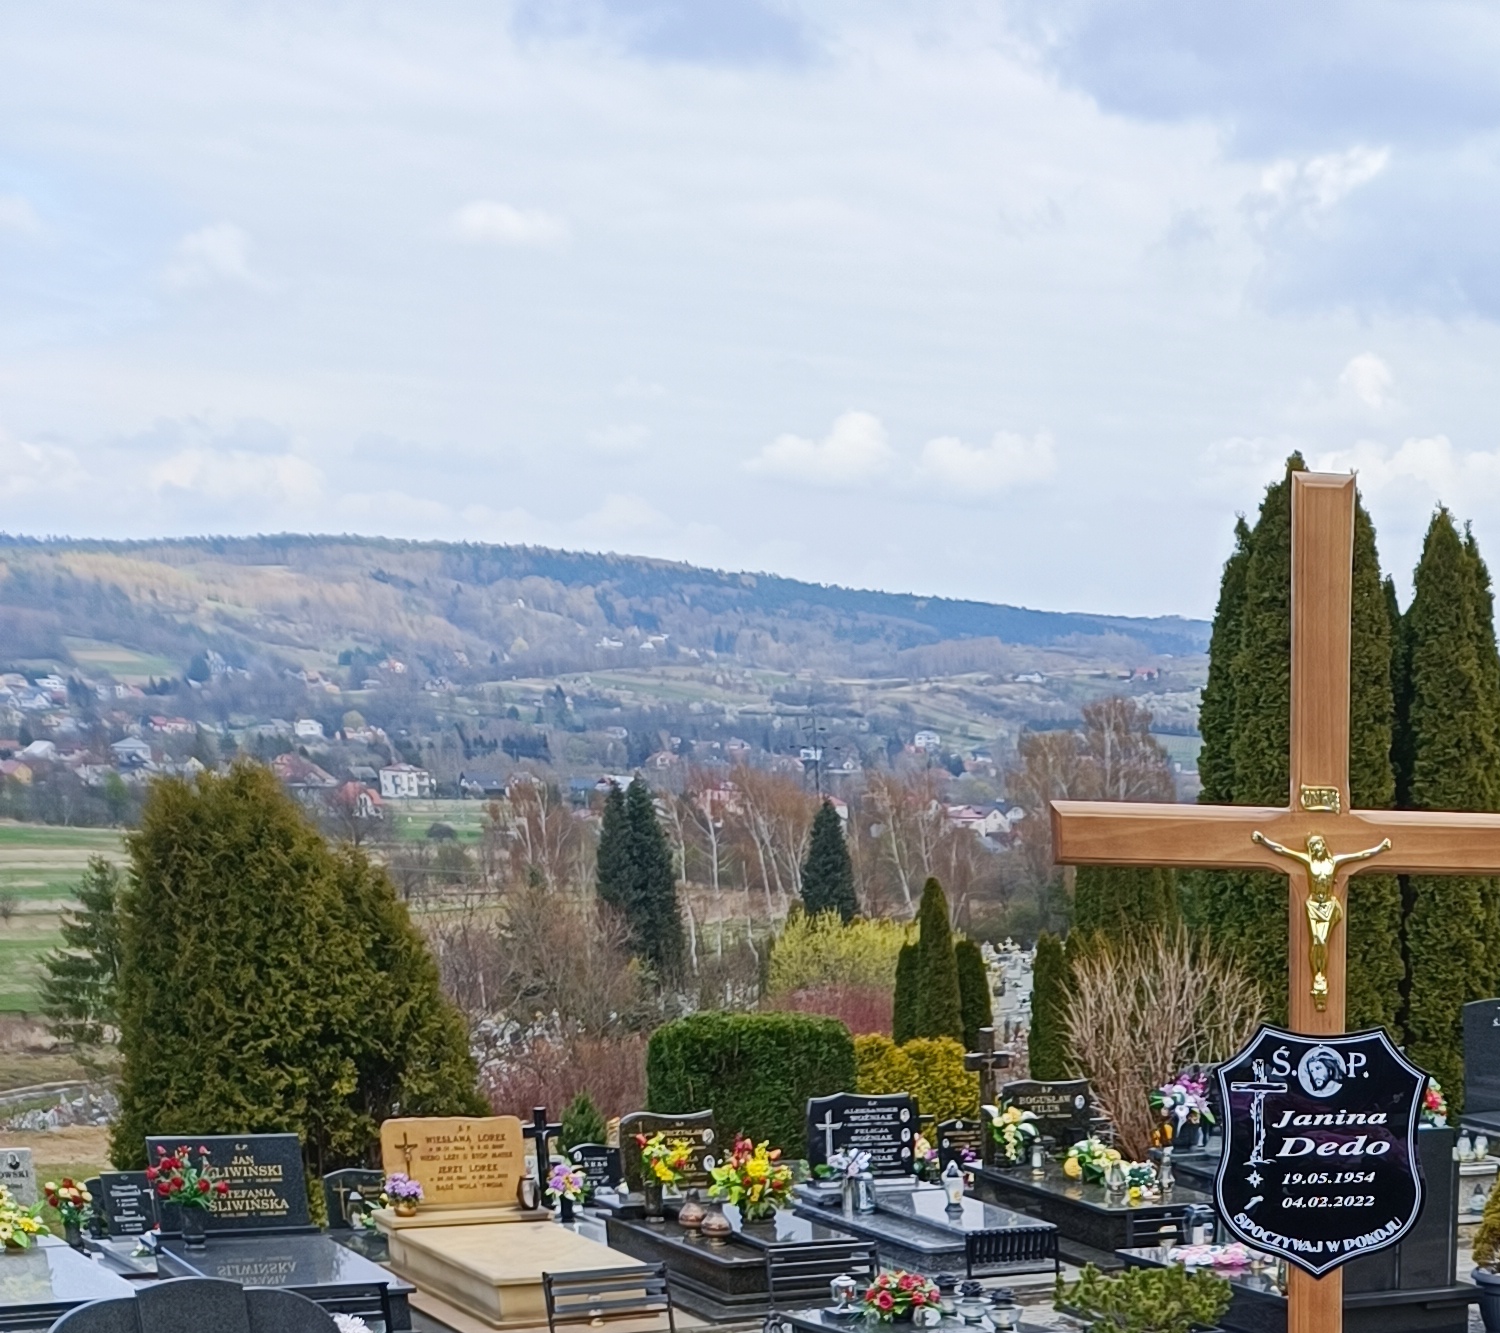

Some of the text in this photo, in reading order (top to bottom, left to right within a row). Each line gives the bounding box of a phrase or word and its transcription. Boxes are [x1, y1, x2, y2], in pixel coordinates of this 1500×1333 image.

[1346, 1052, 1369, 1079] P.
[1272, 1109, 1387, 1128] Janina
[1275, 1135, 1391, 1158] Dedo
[232, 1155, 254, 1165] JAN
[1282, 1172, 1376, 1185] 19.05.1954
[1282, 1195, 1376, 1209] 04.02.2022
[1233, 1212, 1402, 1253] SPOCZYWAJ W POKOJU
